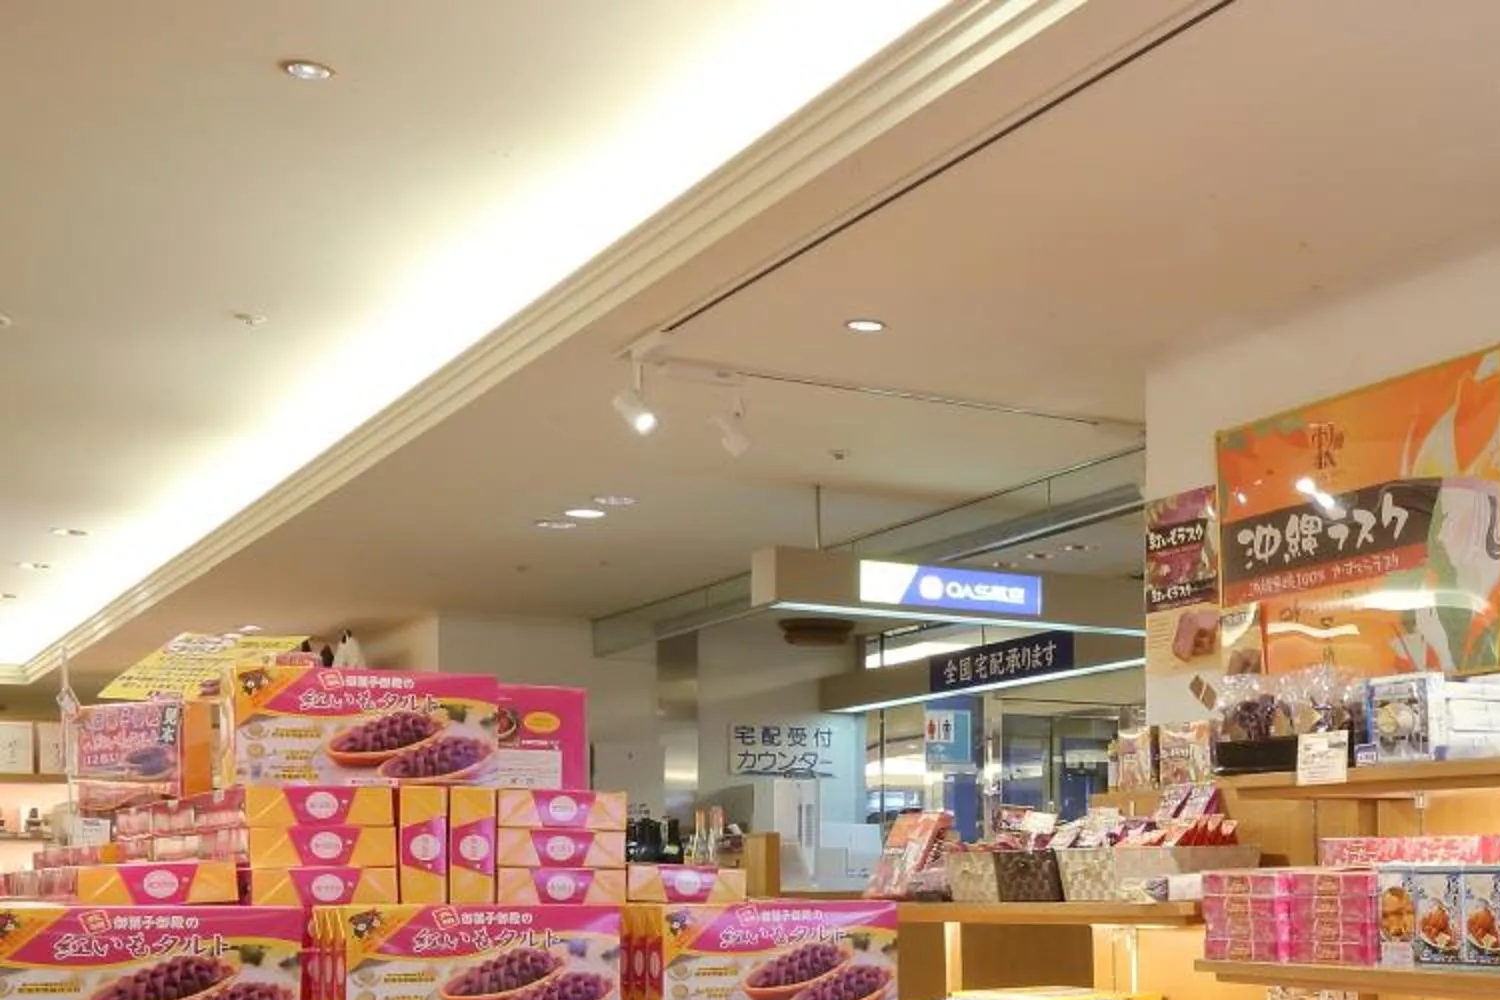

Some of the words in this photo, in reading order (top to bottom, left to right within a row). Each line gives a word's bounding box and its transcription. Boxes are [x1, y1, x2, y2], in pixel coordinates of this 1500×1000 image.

[943, 640, 1057, 685] 全国宅配承ります
[734, 726, 832, 747] 宅配受付
[736, 750, 832, 770] カウンター
[54, 932, 231, 959] 紅いもタルト
